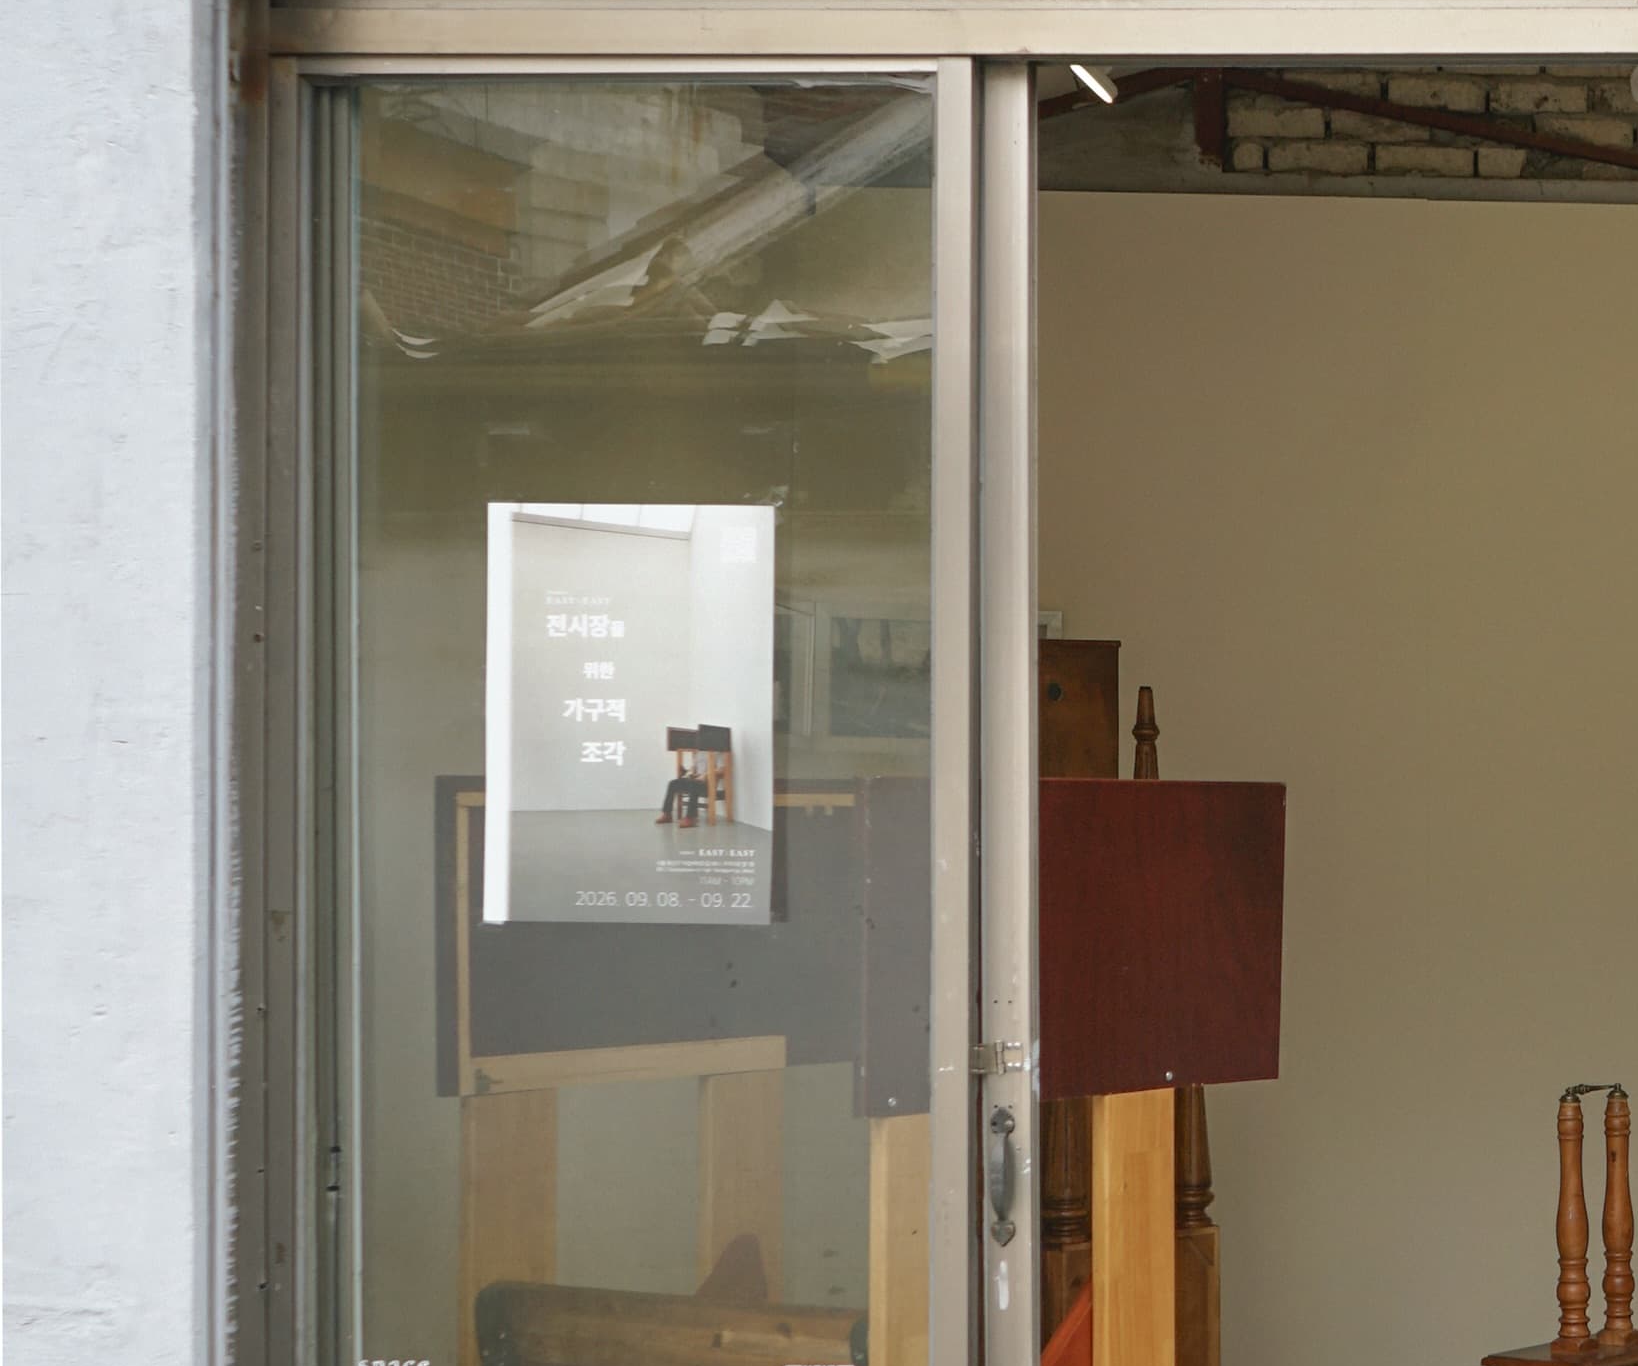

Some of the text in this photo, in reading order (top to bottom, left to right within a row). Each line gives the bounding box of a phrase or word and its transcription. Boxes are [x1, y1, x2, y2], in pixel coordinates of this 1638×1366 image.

[562, 697, 626, 722] 가구적
[580, 740, 626, 766] 조각
[700, 892, 725, 907] 09.
